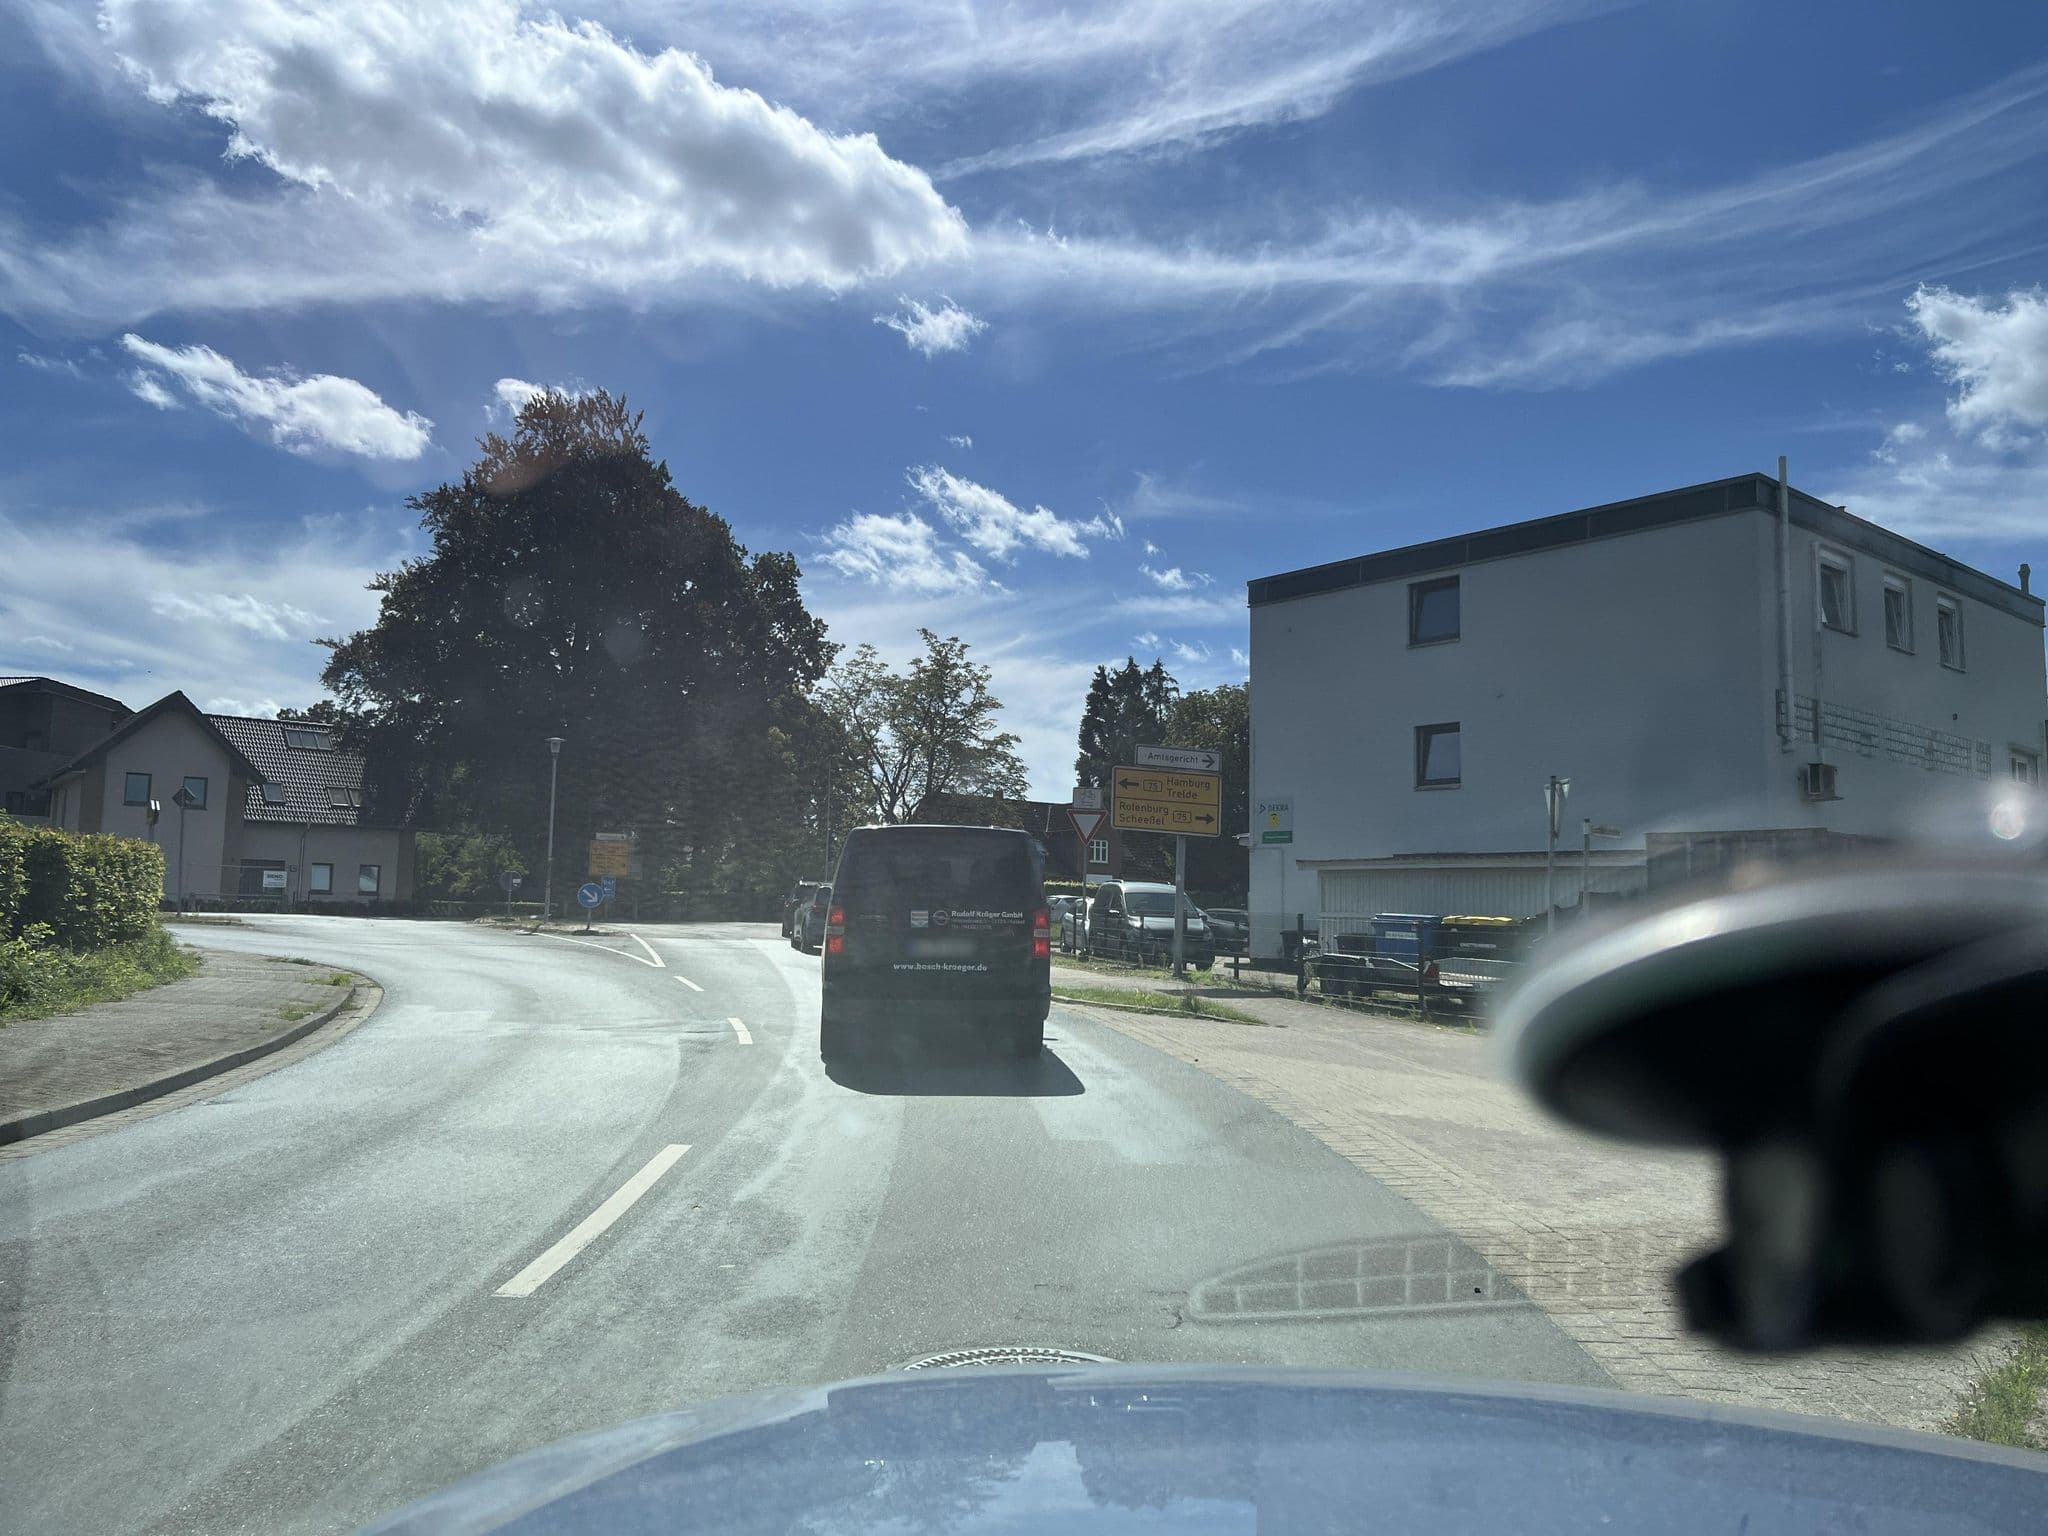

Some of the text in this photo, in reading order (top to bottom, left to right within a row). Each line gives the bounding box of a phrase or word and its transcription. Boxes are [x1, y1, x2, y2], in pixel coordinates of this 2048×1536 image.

[1147, 752, 1198, 764] Amtsgericht
[1166, 776, 1210, 791] Hamburg
[1119, 801, 1169, 815] Rotenburg
[1119, 813, 1165, 825] Scheeßel
[951, 910, 975, 918] Rudolf
[1001, 911, 1023, 919] GmbH
